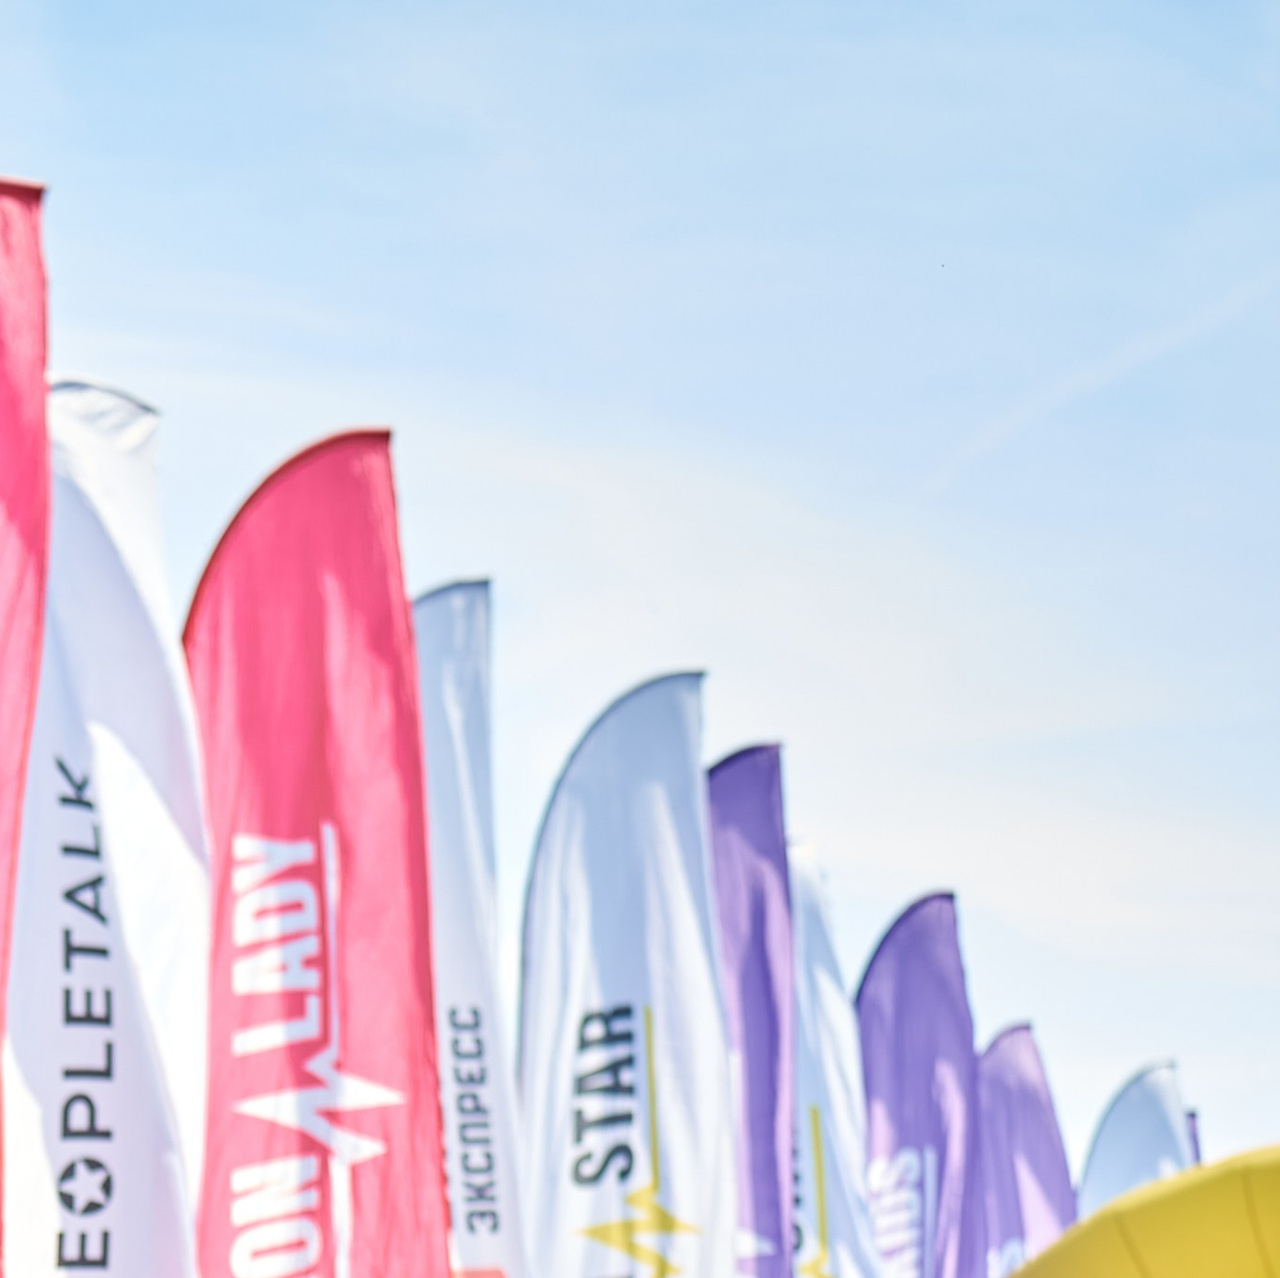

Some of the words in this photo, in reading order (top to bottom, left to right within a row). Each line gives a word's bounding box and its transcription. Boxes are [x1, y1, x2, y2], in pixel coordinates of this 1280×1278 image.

[231, 832, 317, 1055] LADY
[449, 1006, 500, 1236] ЭКСПРЕСС
[572, 1003, 636, 1188] STAR
